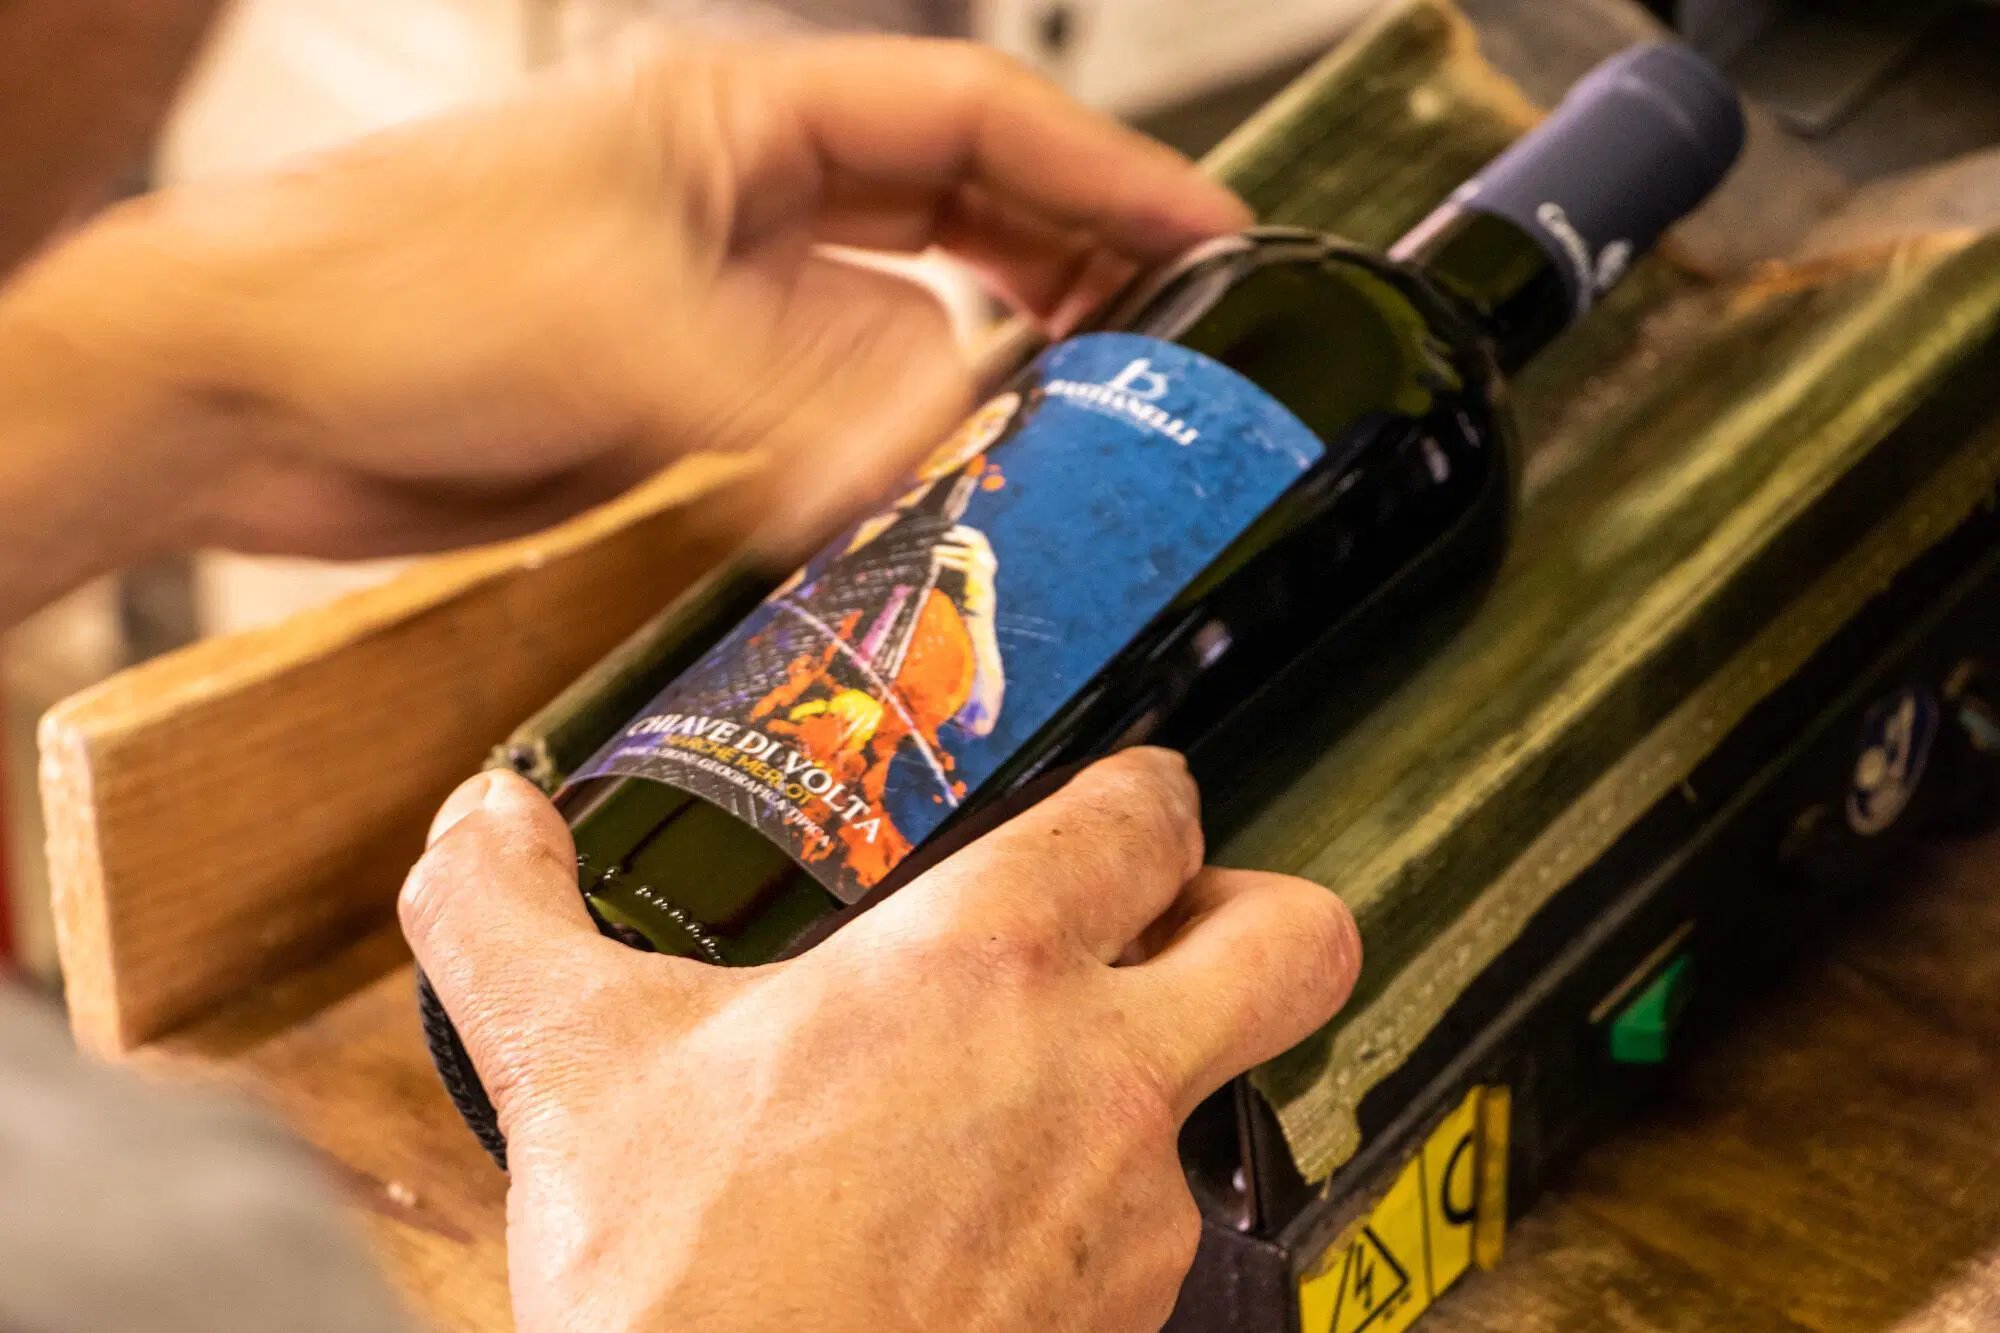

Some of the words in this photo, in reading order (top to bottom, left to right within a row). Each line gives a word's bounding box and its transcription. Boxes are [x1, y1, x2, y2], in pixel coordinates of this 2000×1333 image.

[626, 713, 741, 744] CHIAVE
[733, 729, 783, 761] DI
[783, 750, 881, 845] VOLTA
